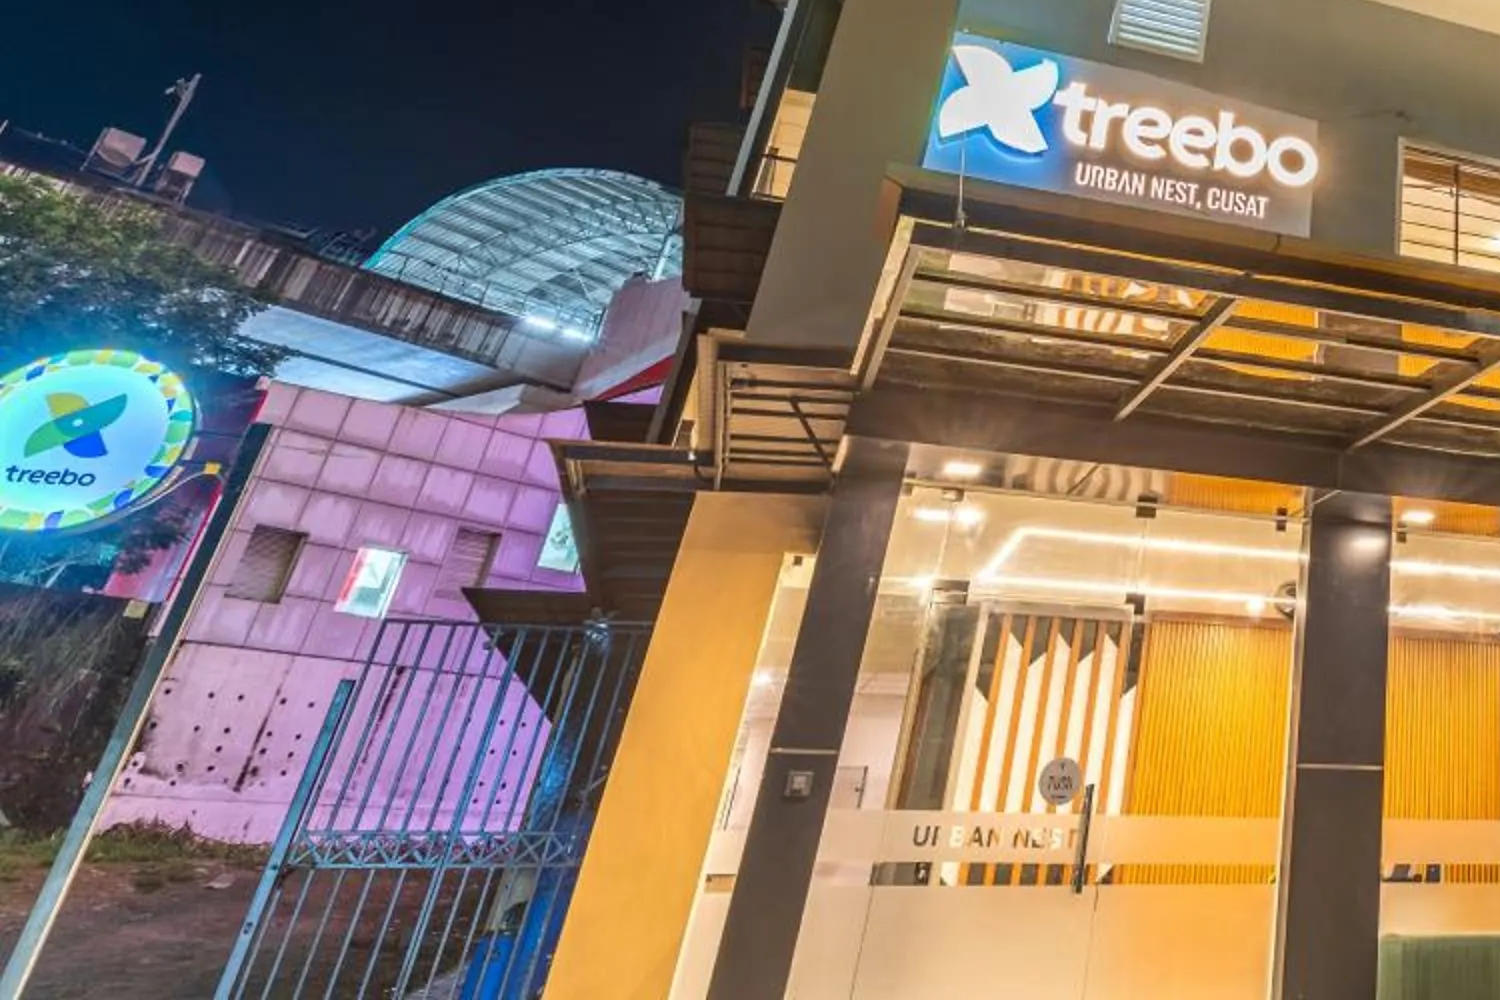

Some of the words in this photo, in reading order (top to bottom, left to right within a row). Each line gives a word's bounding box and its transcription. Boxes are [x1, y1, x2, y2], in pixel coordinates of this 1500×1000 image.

[1052, 81, 1318, 186] treebo
[1074, 162, 1146, 197] URBAN
[1149, 176, 1201, 210] NEST,
[1206, 186, 1270, 219] CUSAT
[5, 465, 96, 487] treebo
